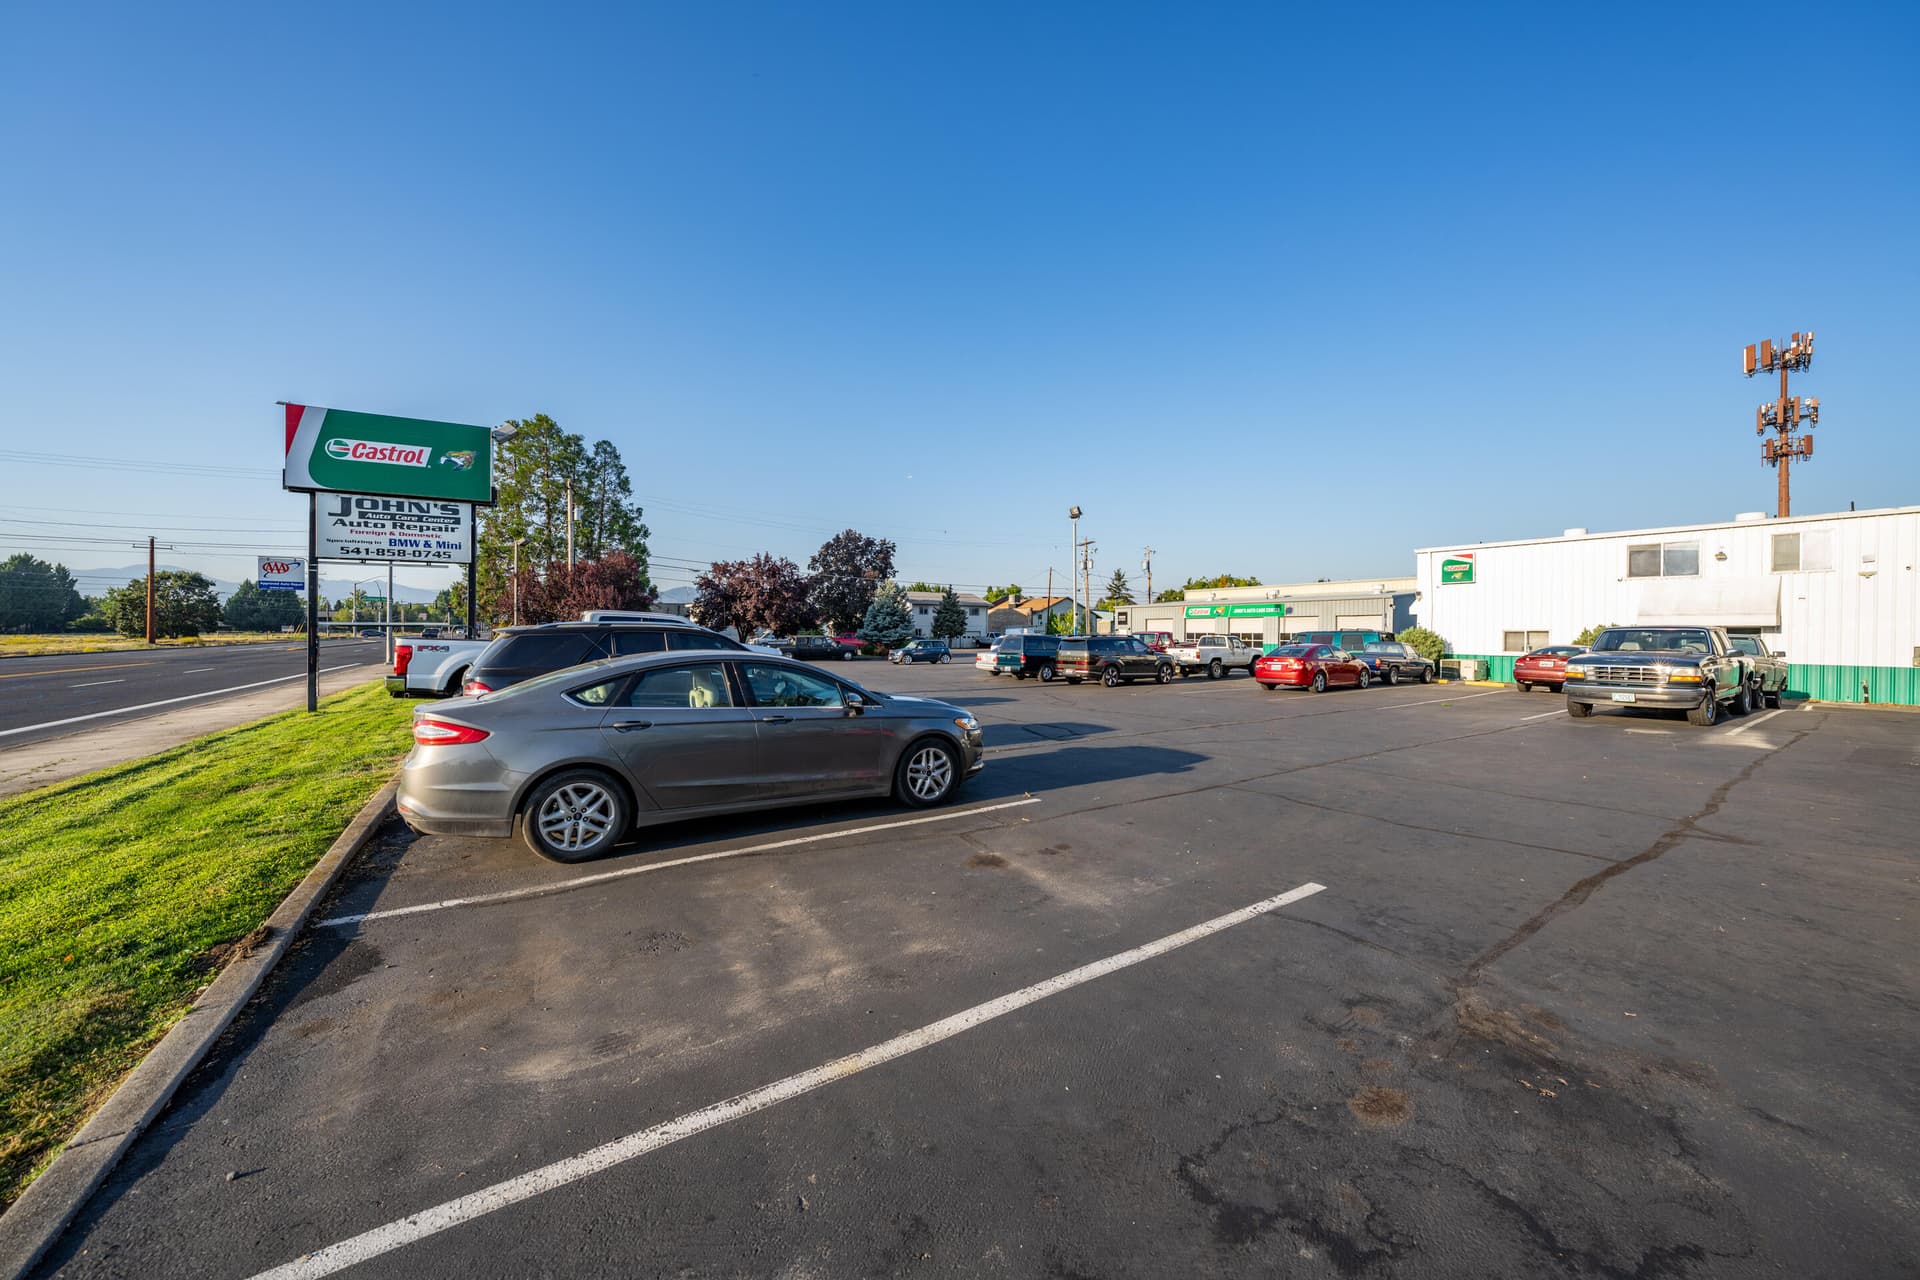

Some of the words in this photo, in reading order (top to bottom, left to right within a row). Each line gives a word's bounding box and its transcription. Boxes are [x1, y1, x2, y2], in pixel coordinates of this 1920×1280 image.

[352, 442, 424, 465] Castrol
[328, 496, 460, 517] JOHN'S
[364, 512, 391, 520] Auto
[332, 518, 386, 529] Auto
[392, 521, 459, 533] Repair
[349, 528, 387, 537] Foreign
[398, 531, 443, 539] Domestic
[388, 538, 421, 549] BMW
[423, 539, 433, 549] &
[435, 540, 462, 550] Mini
[340, 546, 452, 559] 541-858-0745
[262, 561, 289, 574] AAA
